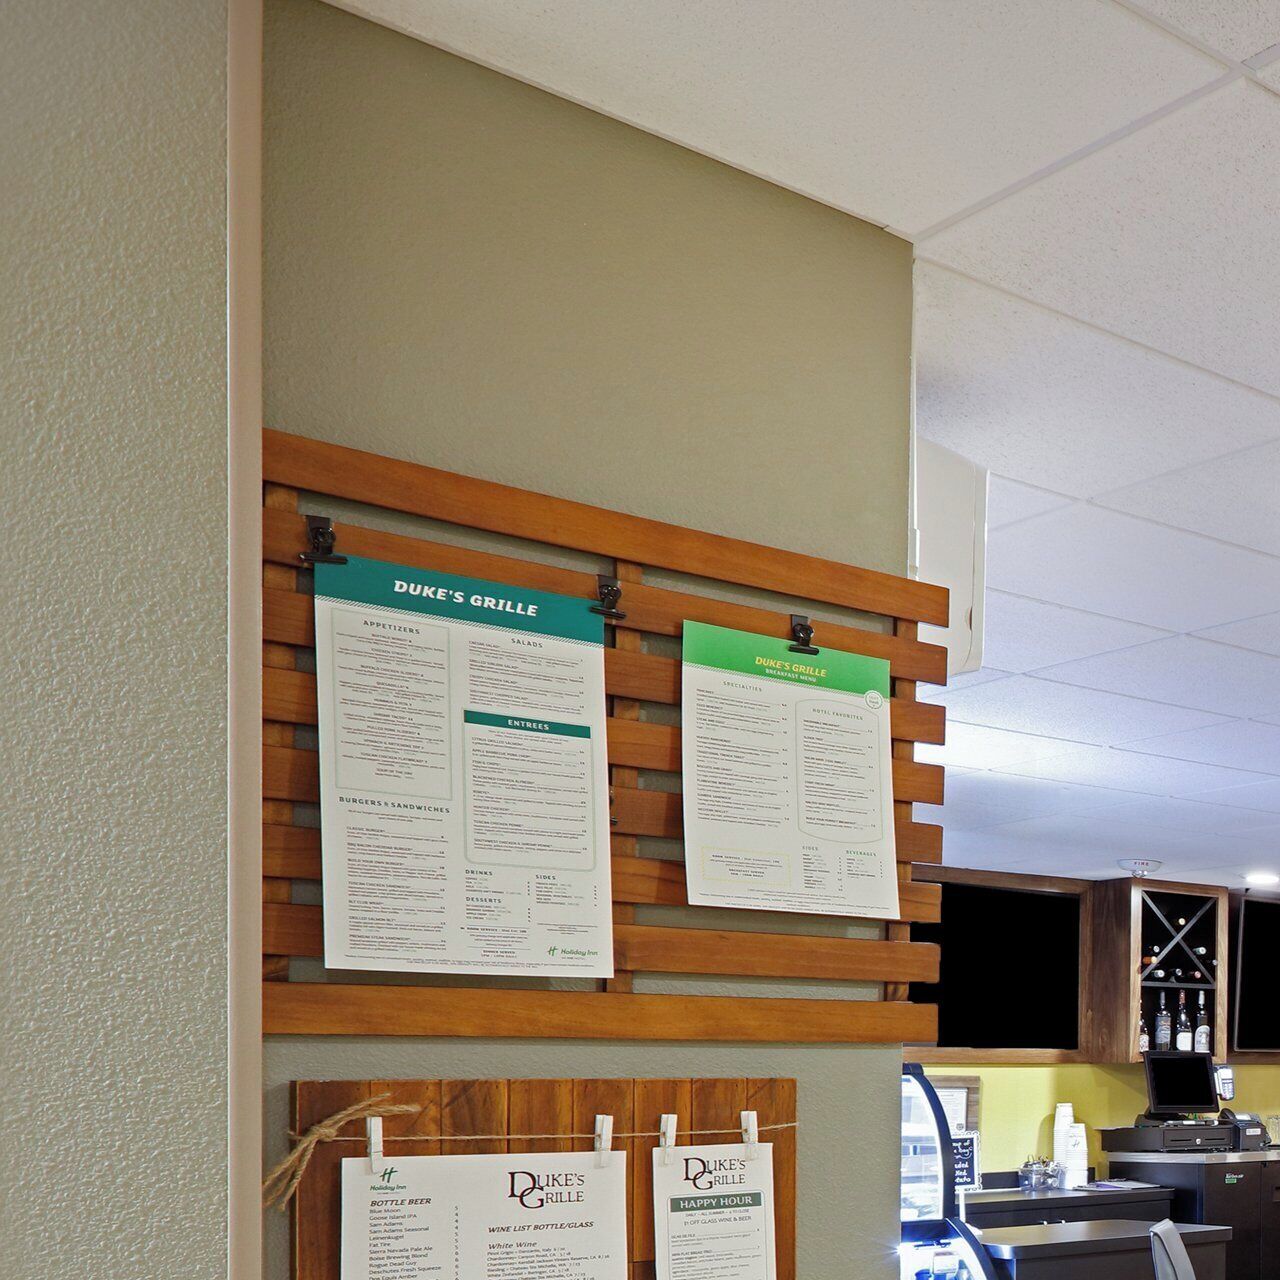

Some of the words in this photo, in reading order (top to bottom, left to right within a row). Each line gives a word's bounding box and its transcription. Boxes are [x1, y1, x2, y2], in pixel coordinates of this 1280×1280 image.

[394, 580, 465, 603] DUKE'S
[470, 595, 538, 617] GRILLE
[363, 620, 420, 634] APPETIZERS
[511, 638, 543, 648] SALADS
[755, 657, 790, 671] DUKE'S
[792, 664, 827, 677] GRILLE
[765, 669, 799, 679] BREAKFAST
[800, 674, 817, 682] MENU
[723, 681, 762, 692] SPECIALTIES
[812, 708, 831, 716] HOTEL
[832, 711, 864, 721] FAVORITES
[508, 719, 549, 730] ENTREES
[339, 796, 382, 806] BURGERS
[391, 802, 450, 813] SANDWICHES
[561, 948, 586, 956] Holiday
[683, 1158, 745, 1180] DUKE'S
[508, 1171, 584, 1198] DUKE'S
[693, 1171, 745, 1190] GRILLE
[520, 1186, 584, 1209] GRILLE
[680, 1198, 717, 1208] HAPPY
[720, 1196, 752, 1206] HOUR
[533, 1222, 594, 1231] BOTTLE/GLASS
